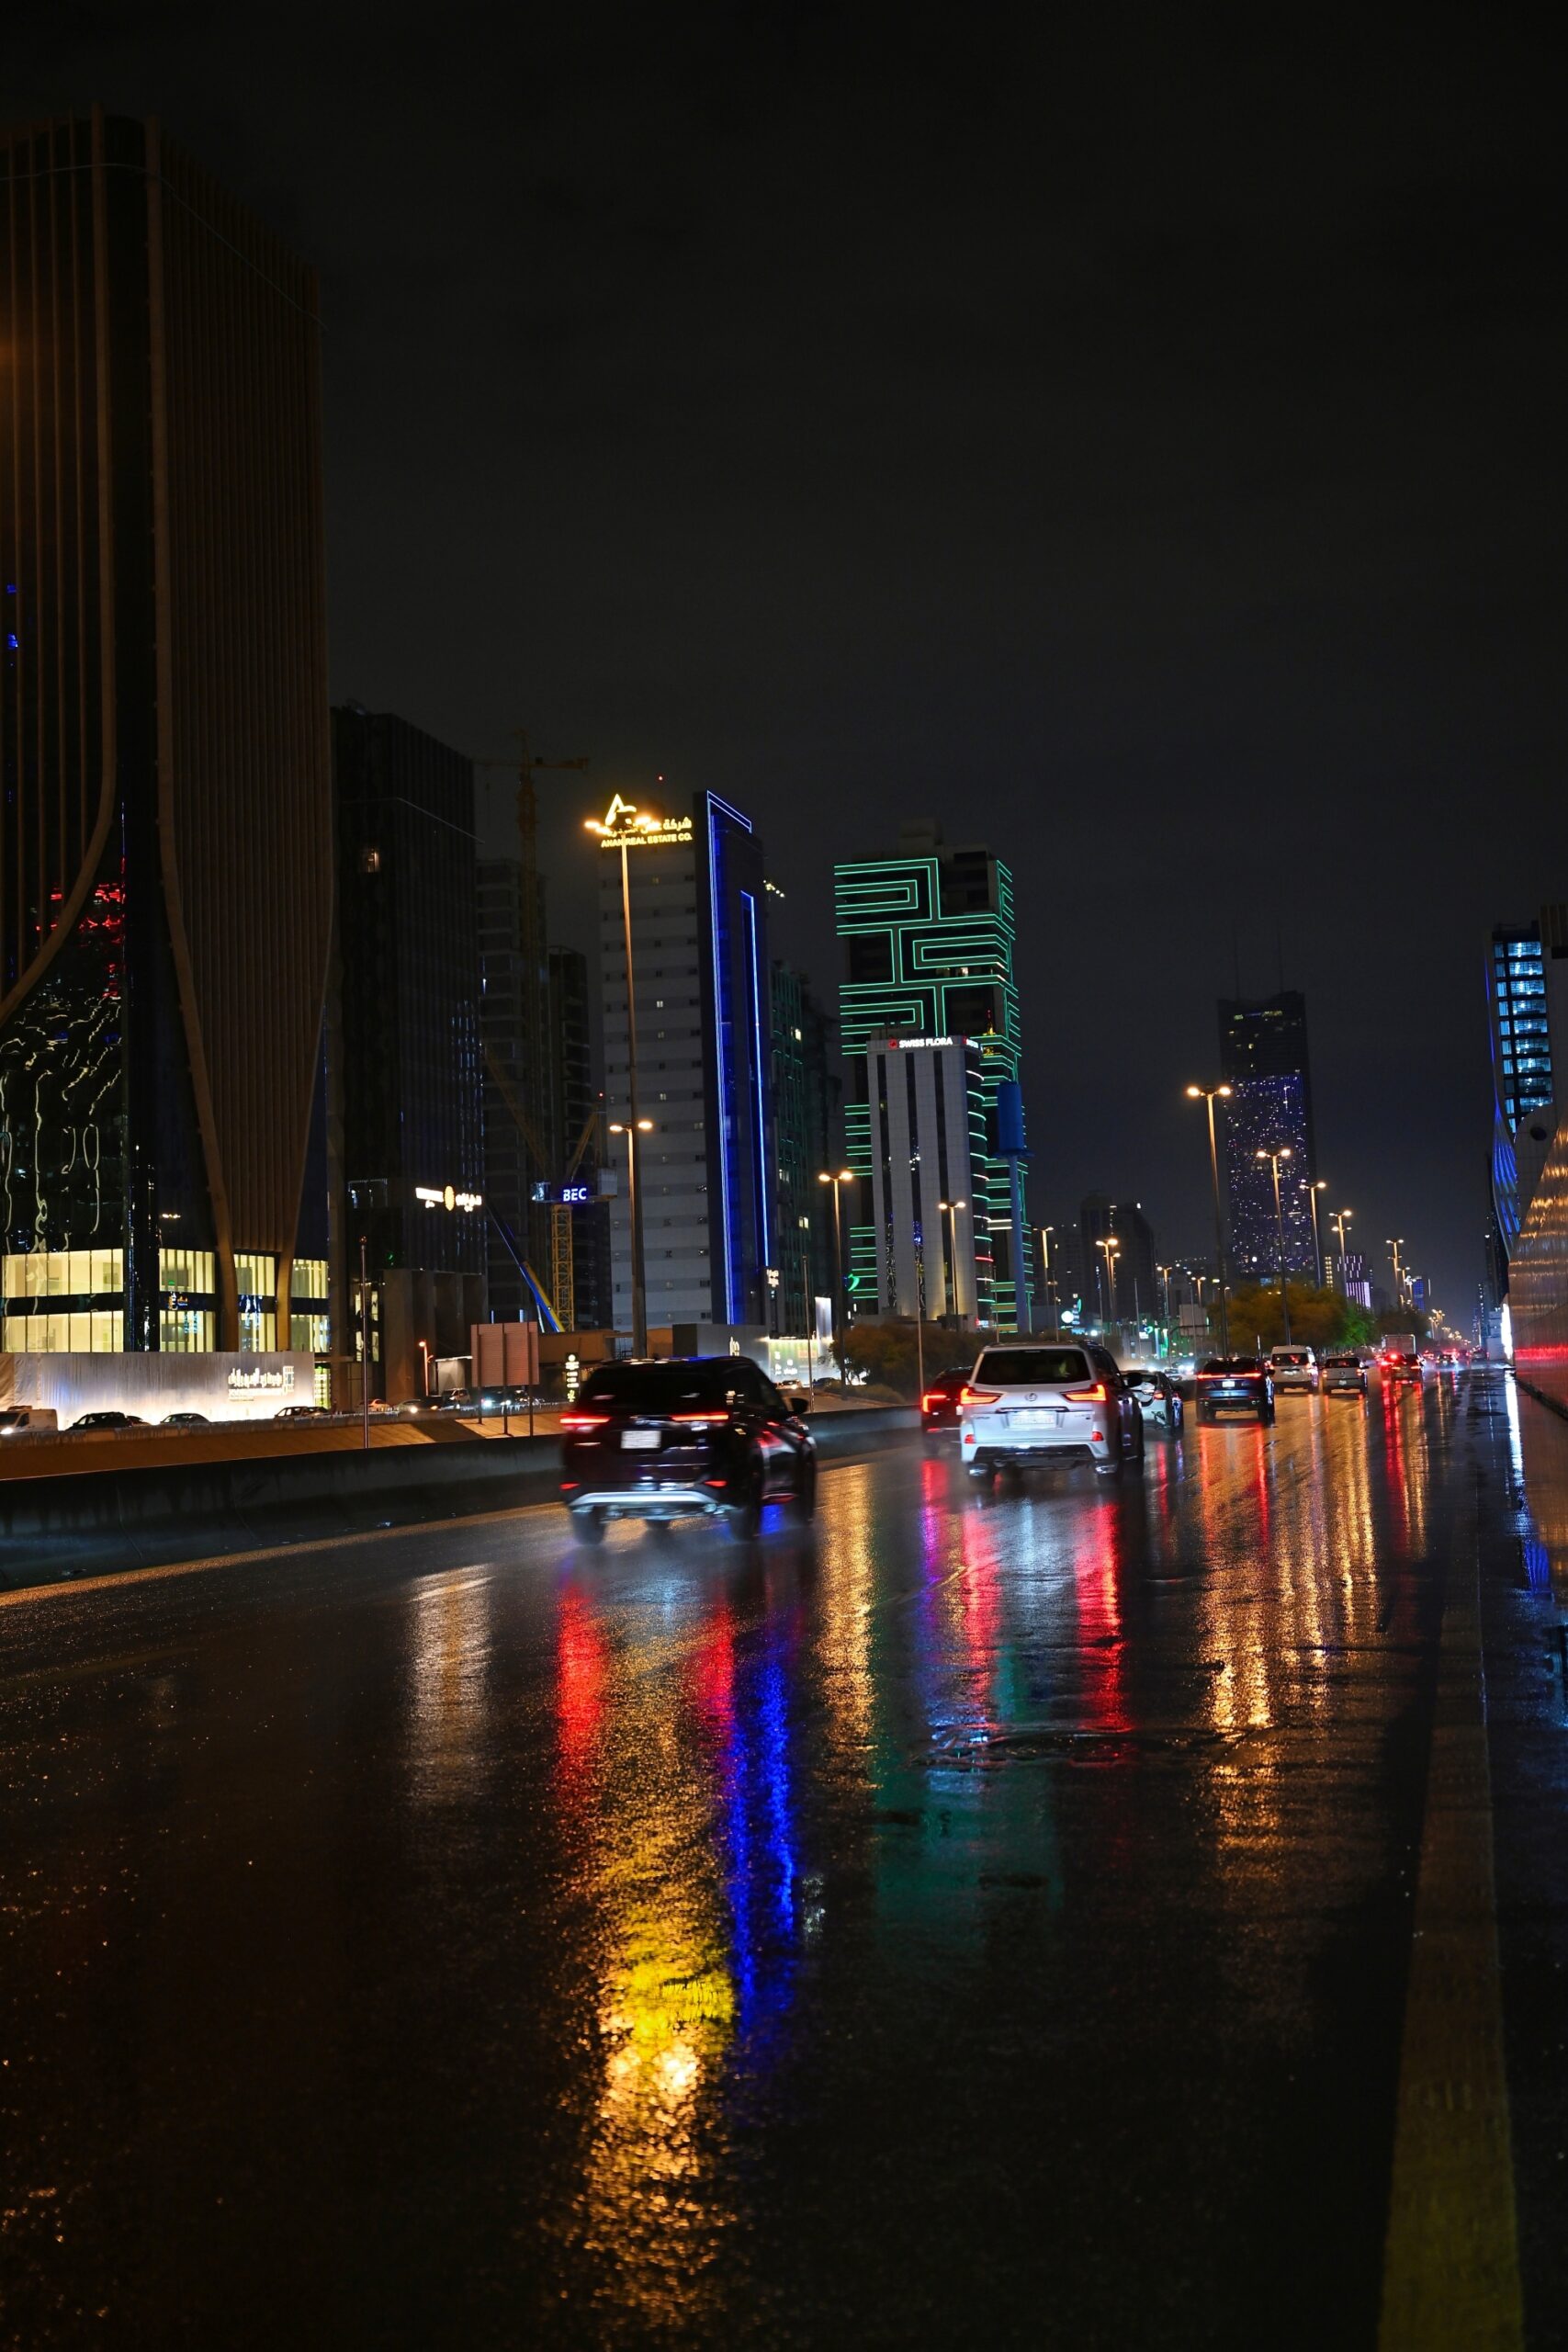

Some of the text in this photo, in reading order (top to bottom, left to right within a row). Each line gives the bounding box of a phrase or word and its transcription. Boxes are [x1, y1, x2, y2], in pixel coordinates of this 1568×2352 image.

[625, 836, 647, 845] REAL
[648, 833, 677, 843] ESTATE
[563, 1187, 587, 1202] BEC
